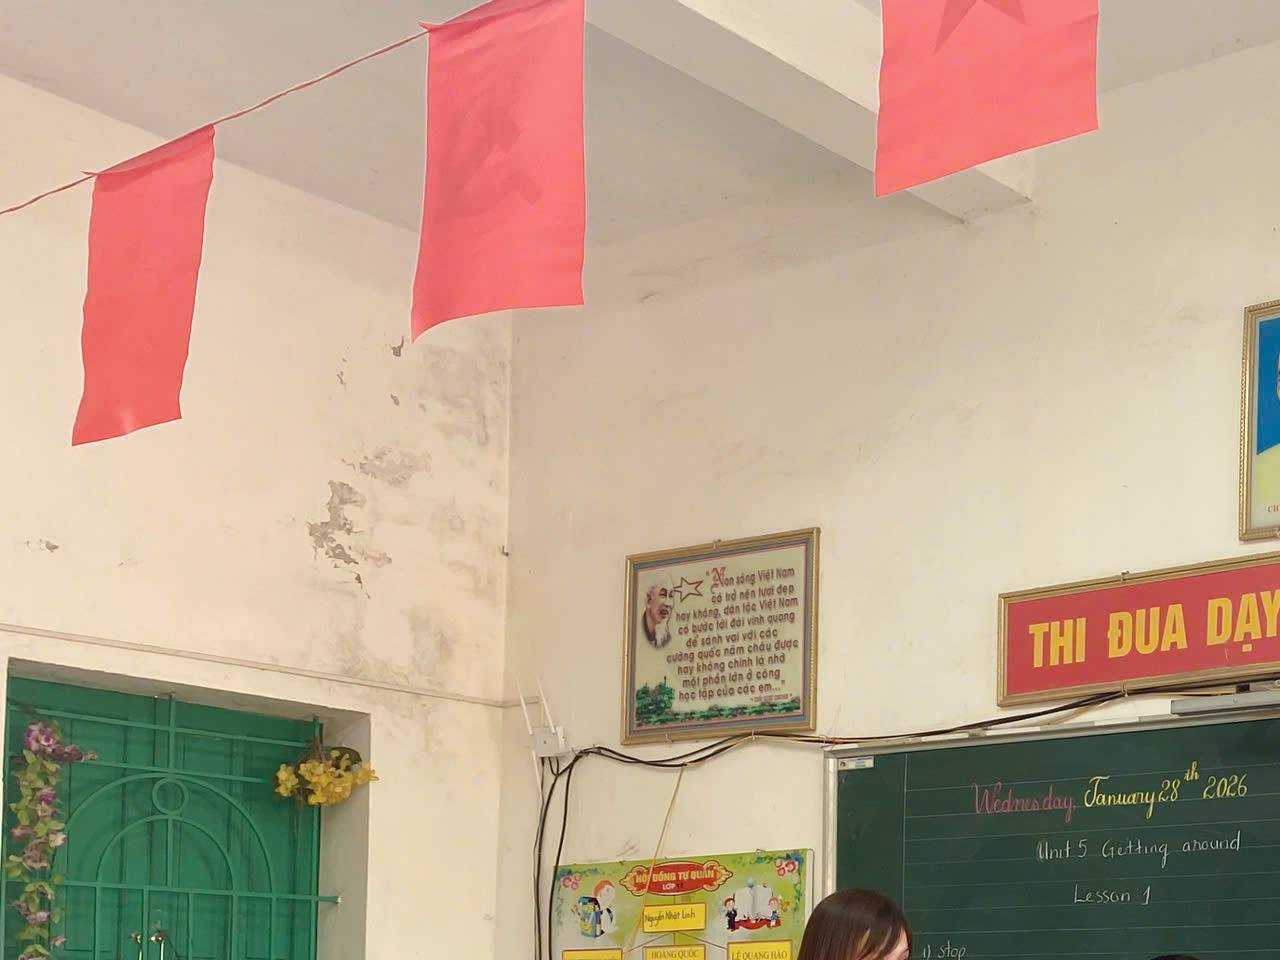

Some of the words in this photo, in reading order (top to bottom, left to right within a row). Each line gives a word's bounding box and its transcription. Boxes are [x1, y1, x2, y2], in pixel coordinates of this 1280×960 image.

[758, 568, 774, 581] Việt
[776, 567, 795, 579] Nam
[676, 611, 690, 622] hay
[759, 599, 776, 611] Việt
[778, 597, 798, 608] Nam
[1029, 620, 1087, 668] THI
[1107, 603, 1187, 658] ĐUA
[677, 665, 694, 676] hay
[1083, 776, 1157, 819] January
[1203, 774, 1248, 799] 2026
[1035, 839, 1072, 863] Unit
[1078, 839, 1088, 859] 5
[1102, 837, 1171, 868] Getting
[1182, 830, 1242, 853] around
[636, 874, 650, 883] HỘ
[1074, 883, 1131, 905] Lesson
[1141, 884, 1151, 906] 1
[742, 950, 769, 960] QUANG
